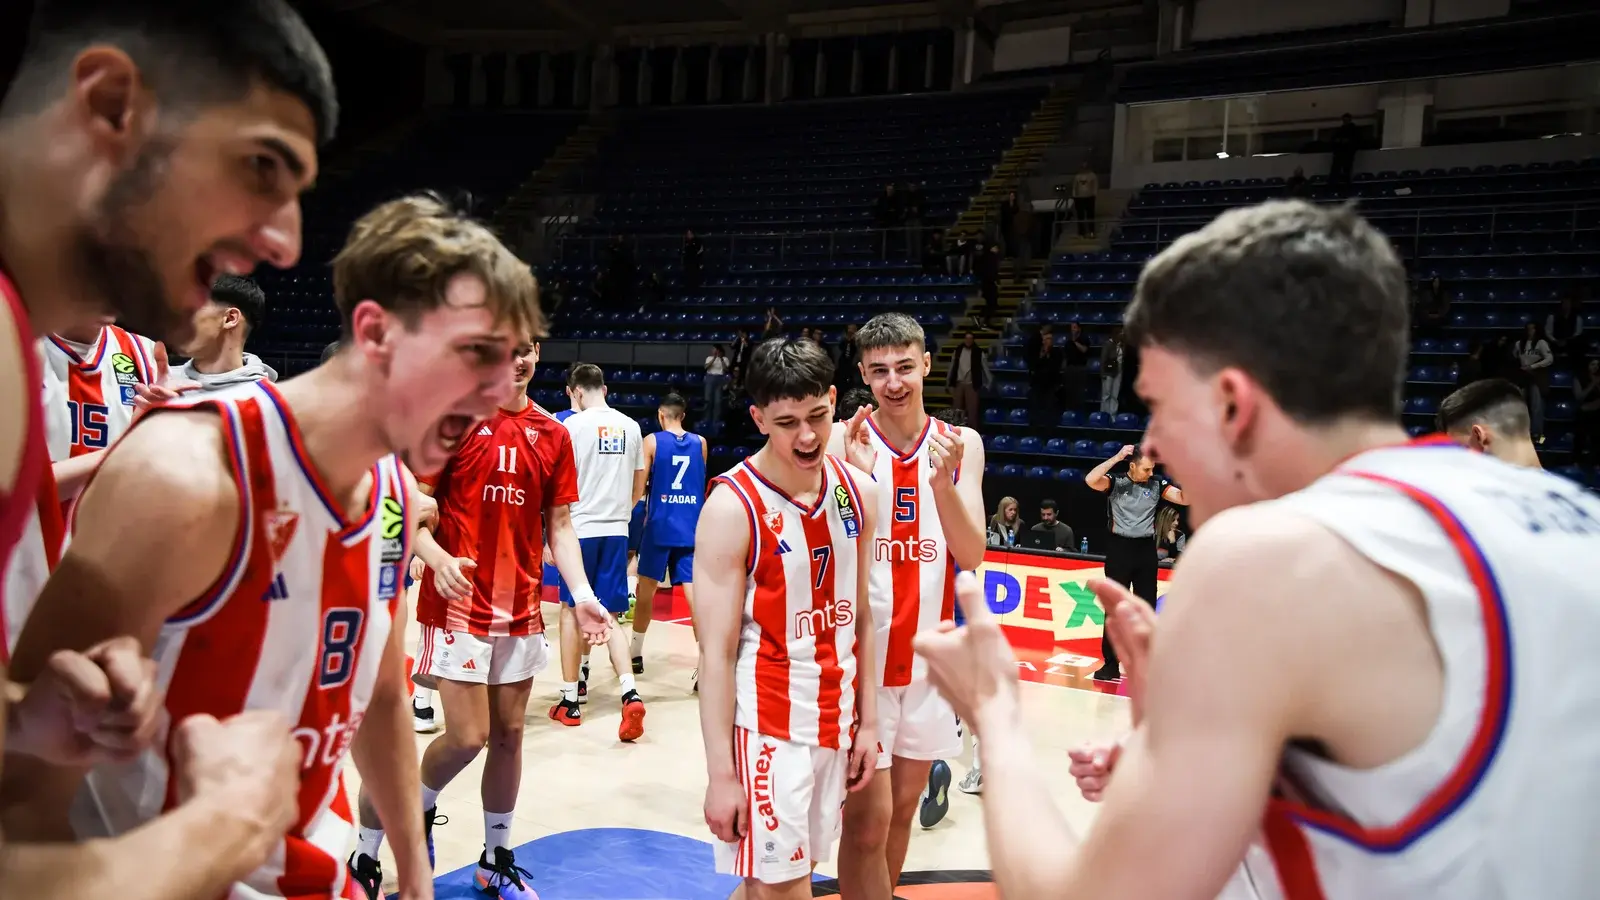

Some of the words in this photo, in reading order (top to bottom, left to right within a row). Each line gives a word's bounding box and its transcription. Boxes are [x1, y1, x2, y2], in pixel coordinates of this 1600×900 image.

[67, 401, 109, 448] 15
[497, 445, 517, 474] 11
[671, 455, 690, 490] 7
[483, 483, 526, 506] mts
[668, 494, 697, 504] ZADAR
[895, 487, 916, 523] 5
[875, 535, 938, 562] mts
[812, 545, 831, 590] 7
[795, 600, 854, 639] mts
[318, 607, 364, 690] 8
[754, 742, 779, 832] carnex
